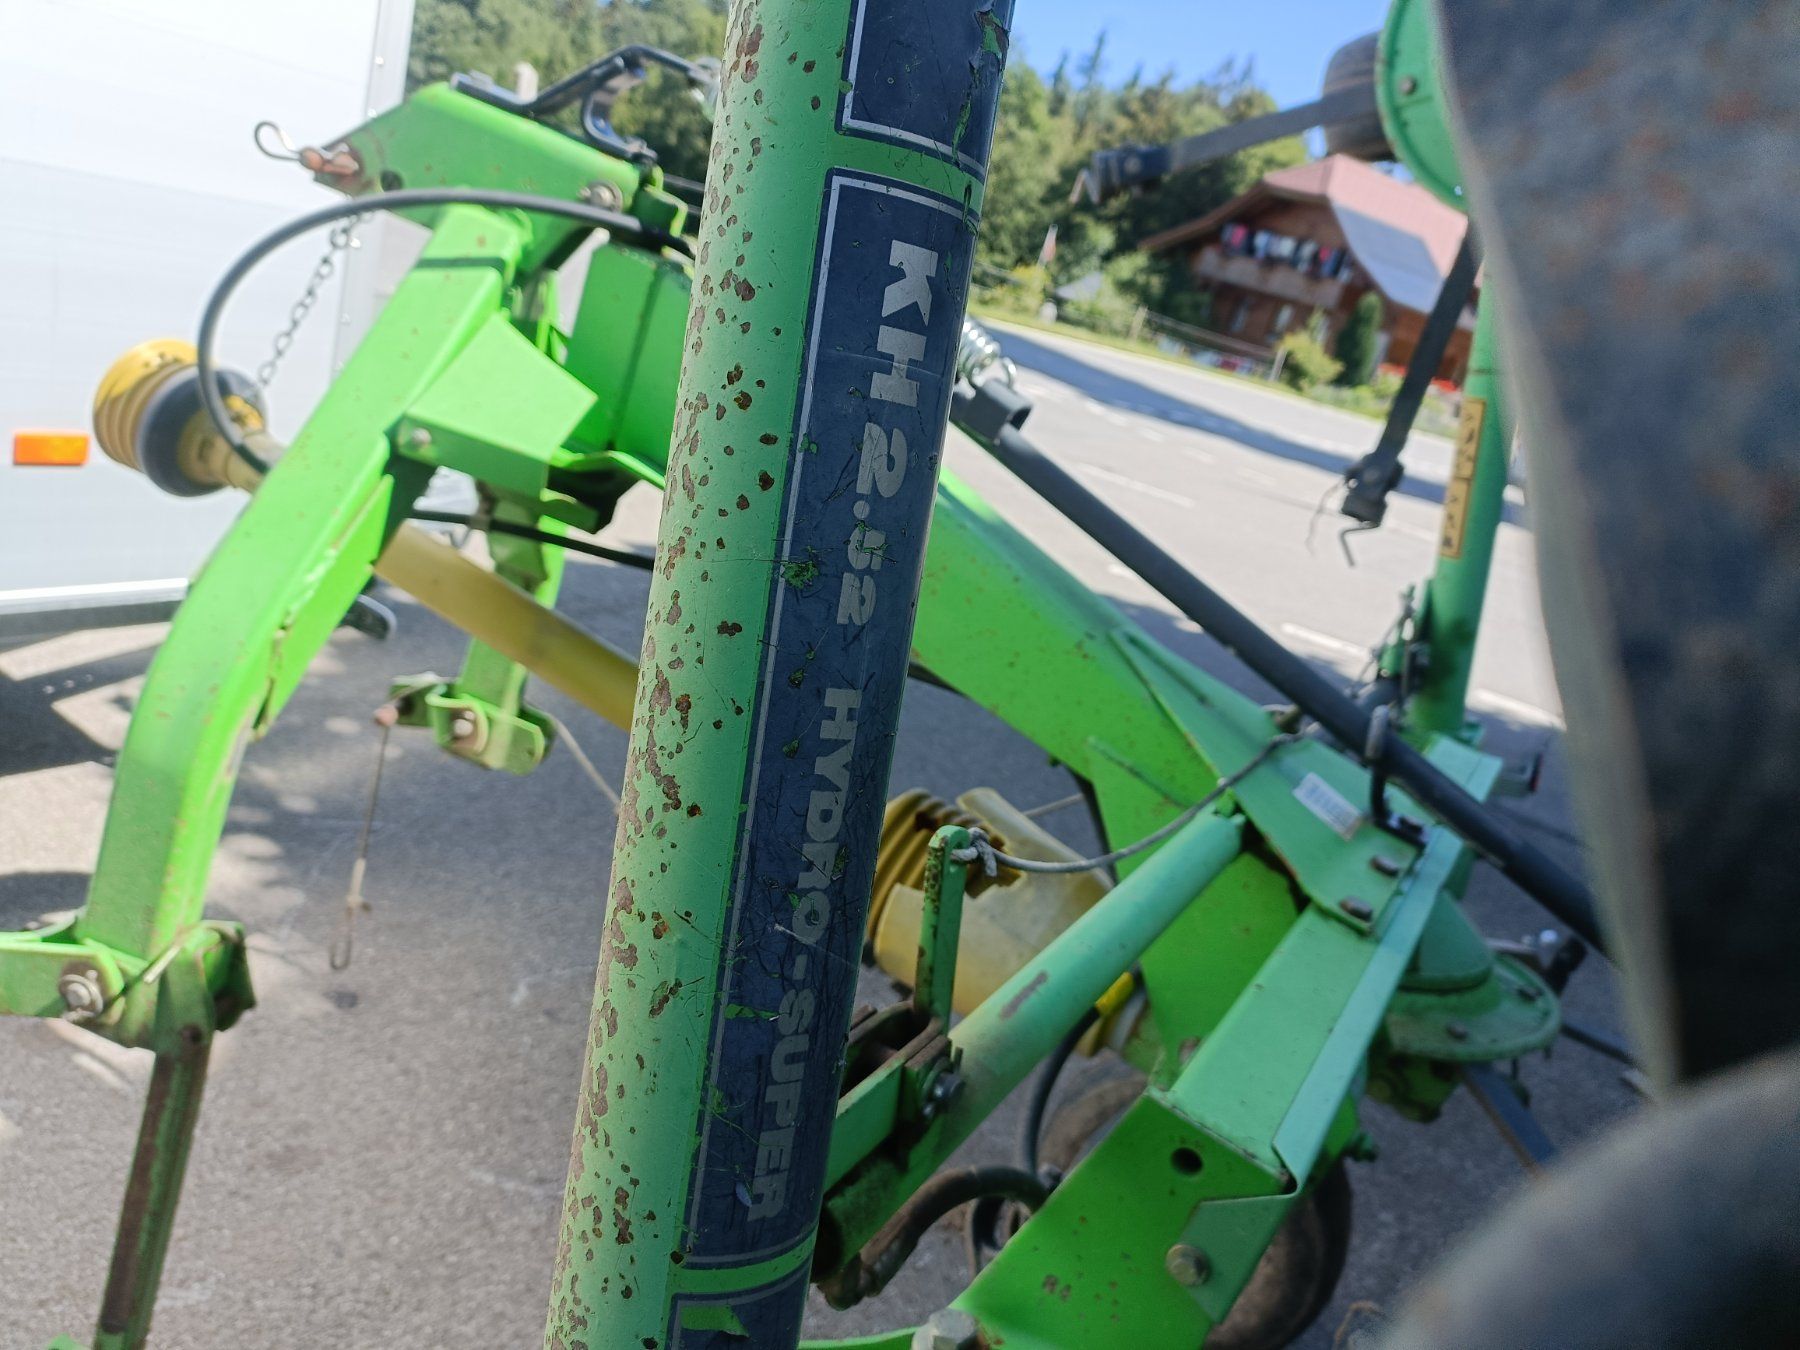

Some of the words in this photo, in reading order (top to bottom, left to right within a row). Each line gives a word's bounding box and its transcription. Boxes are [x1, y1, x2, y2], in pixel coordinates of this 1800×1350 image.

[870, 239, 938, 407] KH
[837, 422, 908, 625] 2.52
[747, 687, 862, 1222] HYDRO-SUPER
